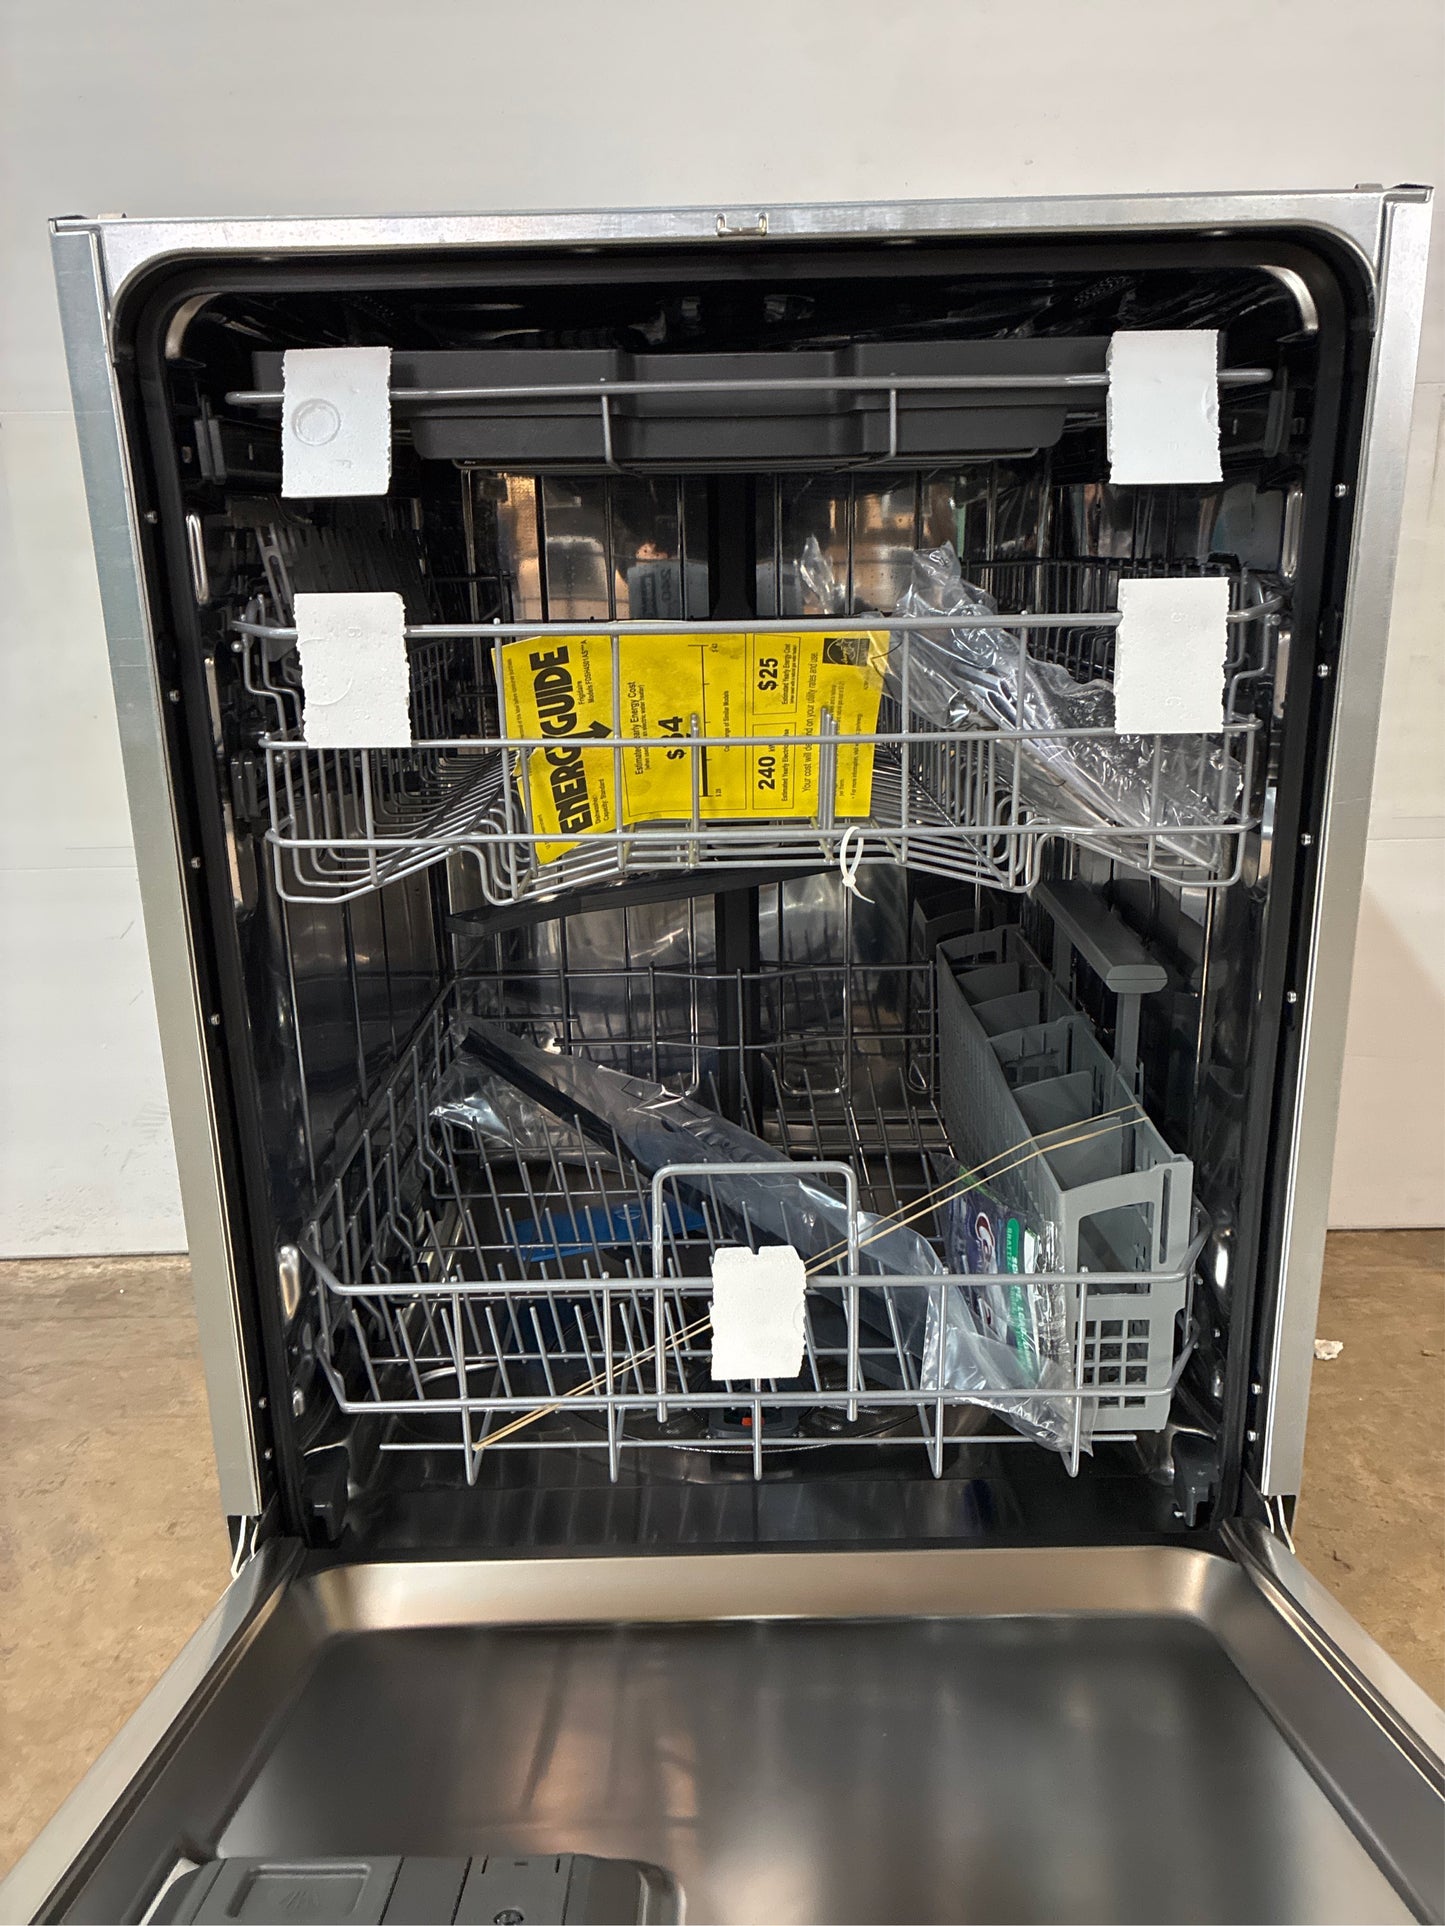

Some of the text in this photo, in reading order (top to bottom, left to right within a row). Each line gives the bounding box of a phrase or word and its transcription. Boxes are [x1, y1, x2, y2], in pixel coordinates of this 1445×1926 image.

[809, 652, 818, 663] use.
[757, 658, 778, 691] $25
[782, 669, 790, 682] Yearly
[808, 664, 816, 673] and
[807, 675, 815, 688] rates
[577, 681, 585, 704] Frigidaire
[586, 685, 595, 703] Models
[628, 682, 637, 698] Cost
[805, 689, 816, 703] utility
[629, 700, 638, 722] Energy
[806, 704, 815, 717] your
[803, 728, 813, 751] dend
[803, 752, 811, 762] will
[758, 756, 775, 790] 240
[782, 763, 790, 777] Yearly
[802, 778, 811, 792] Your
